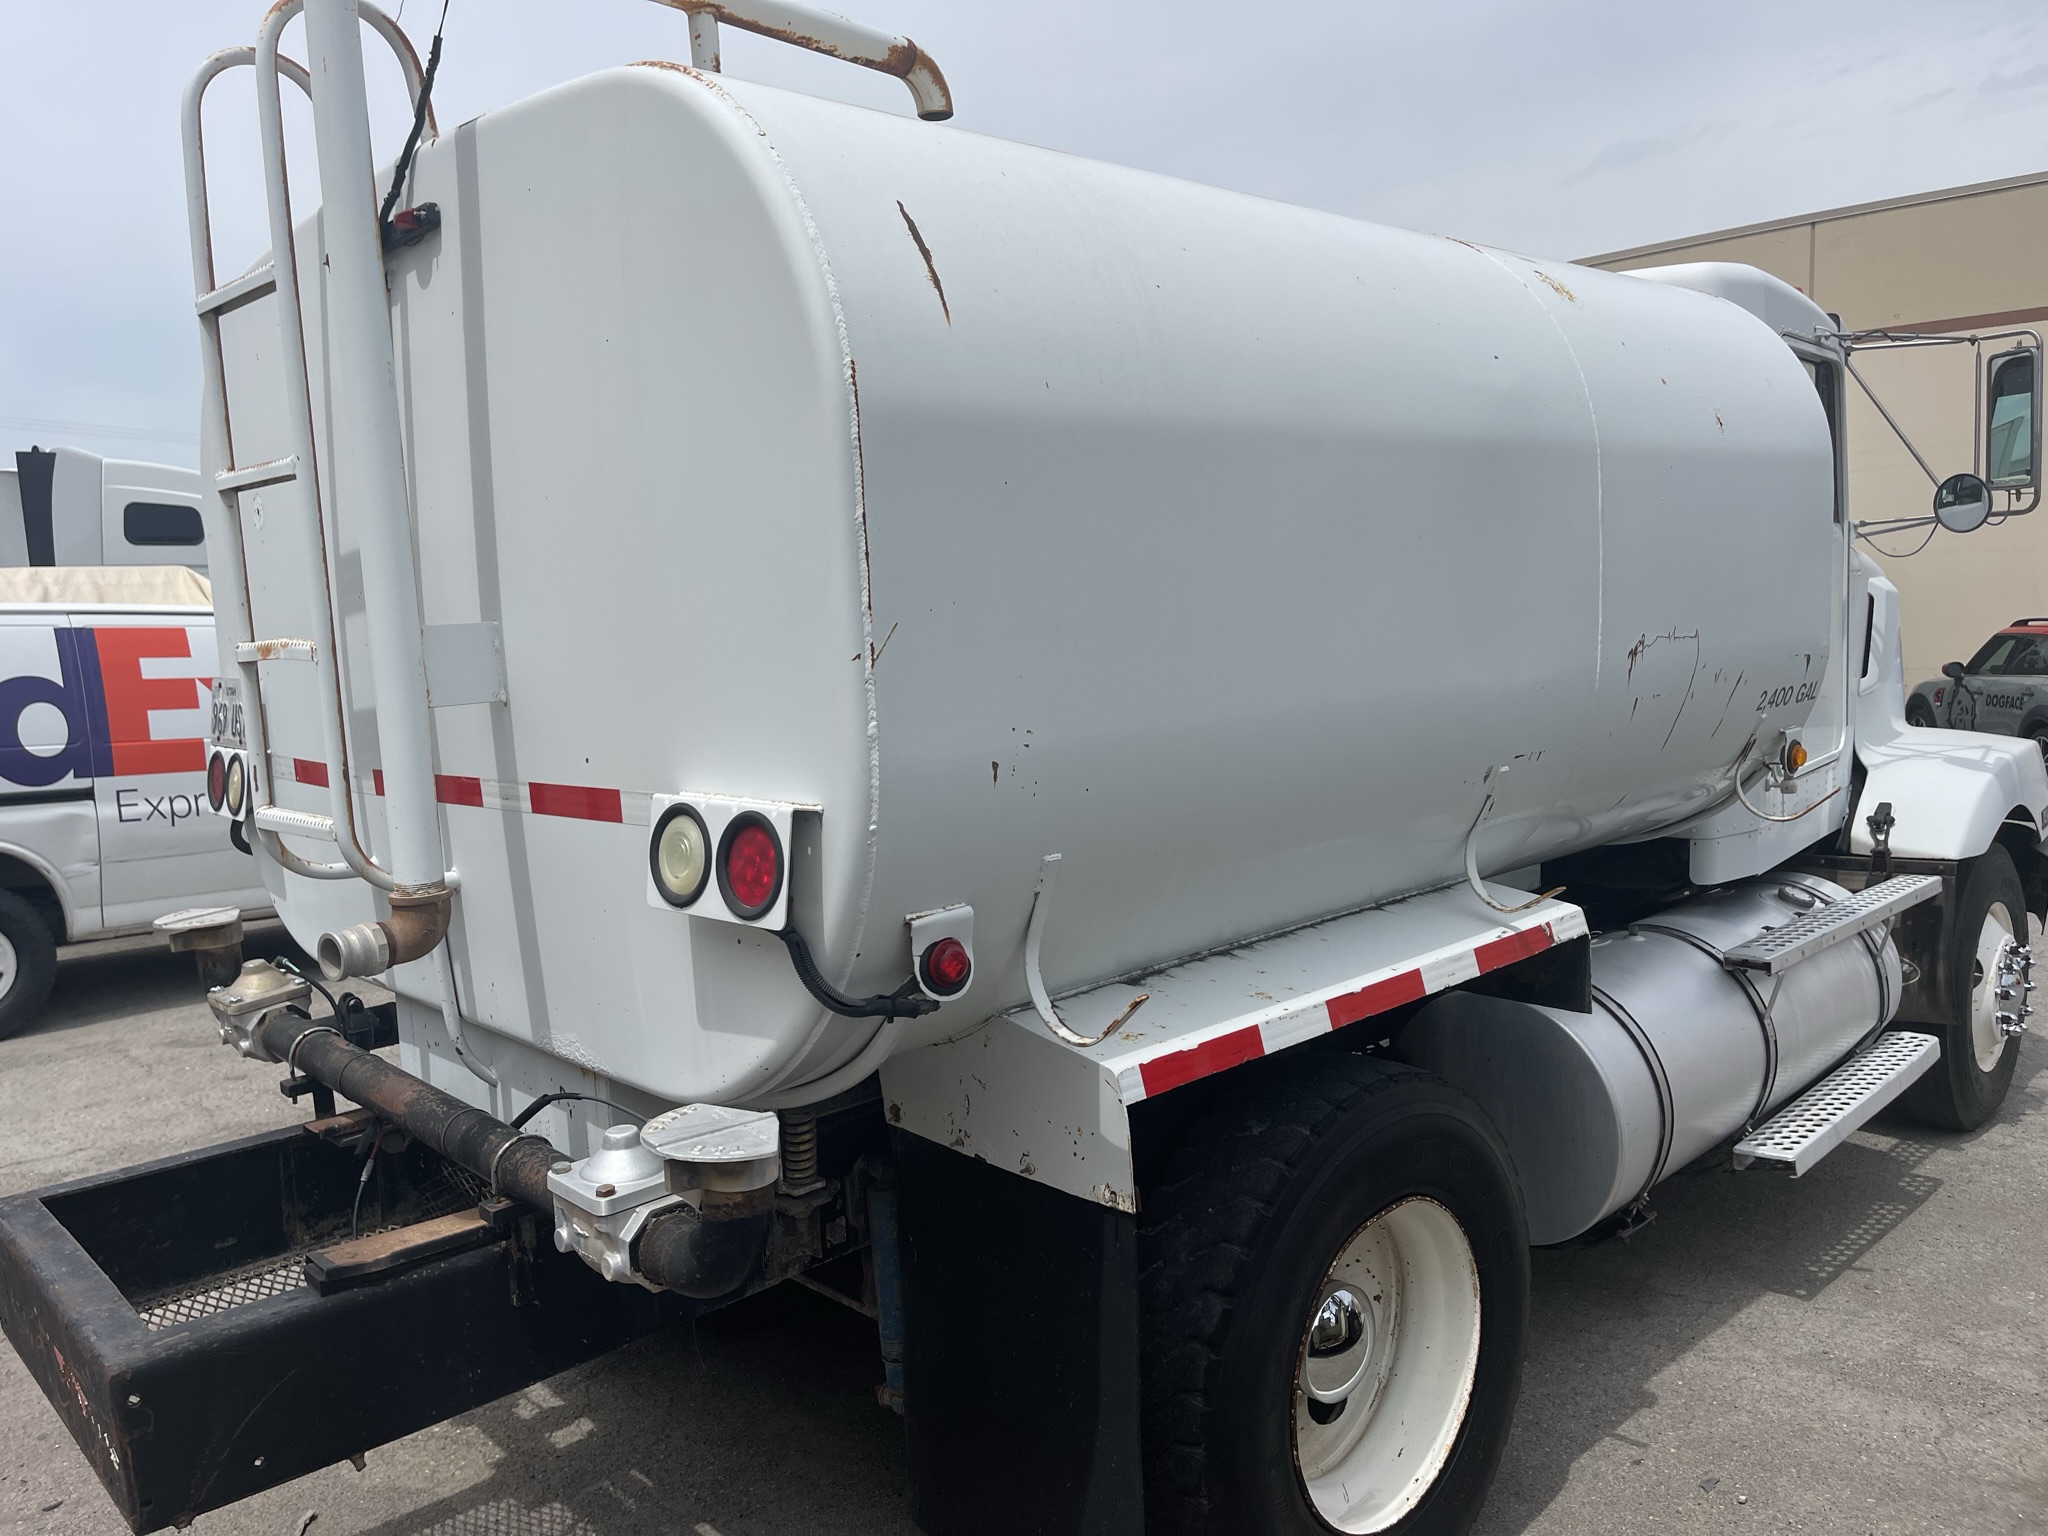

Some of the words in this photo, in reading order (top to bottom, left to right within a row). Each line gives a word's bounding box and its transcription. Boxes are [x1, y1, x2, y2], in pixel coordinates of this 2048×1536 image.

[0, 627, 212, 788] dE
[1755, 684, 1794, 712] 2,400
[1796, 681, 1818, 703] GAL
[1985, 694, 2025, 710] DOGFACE
